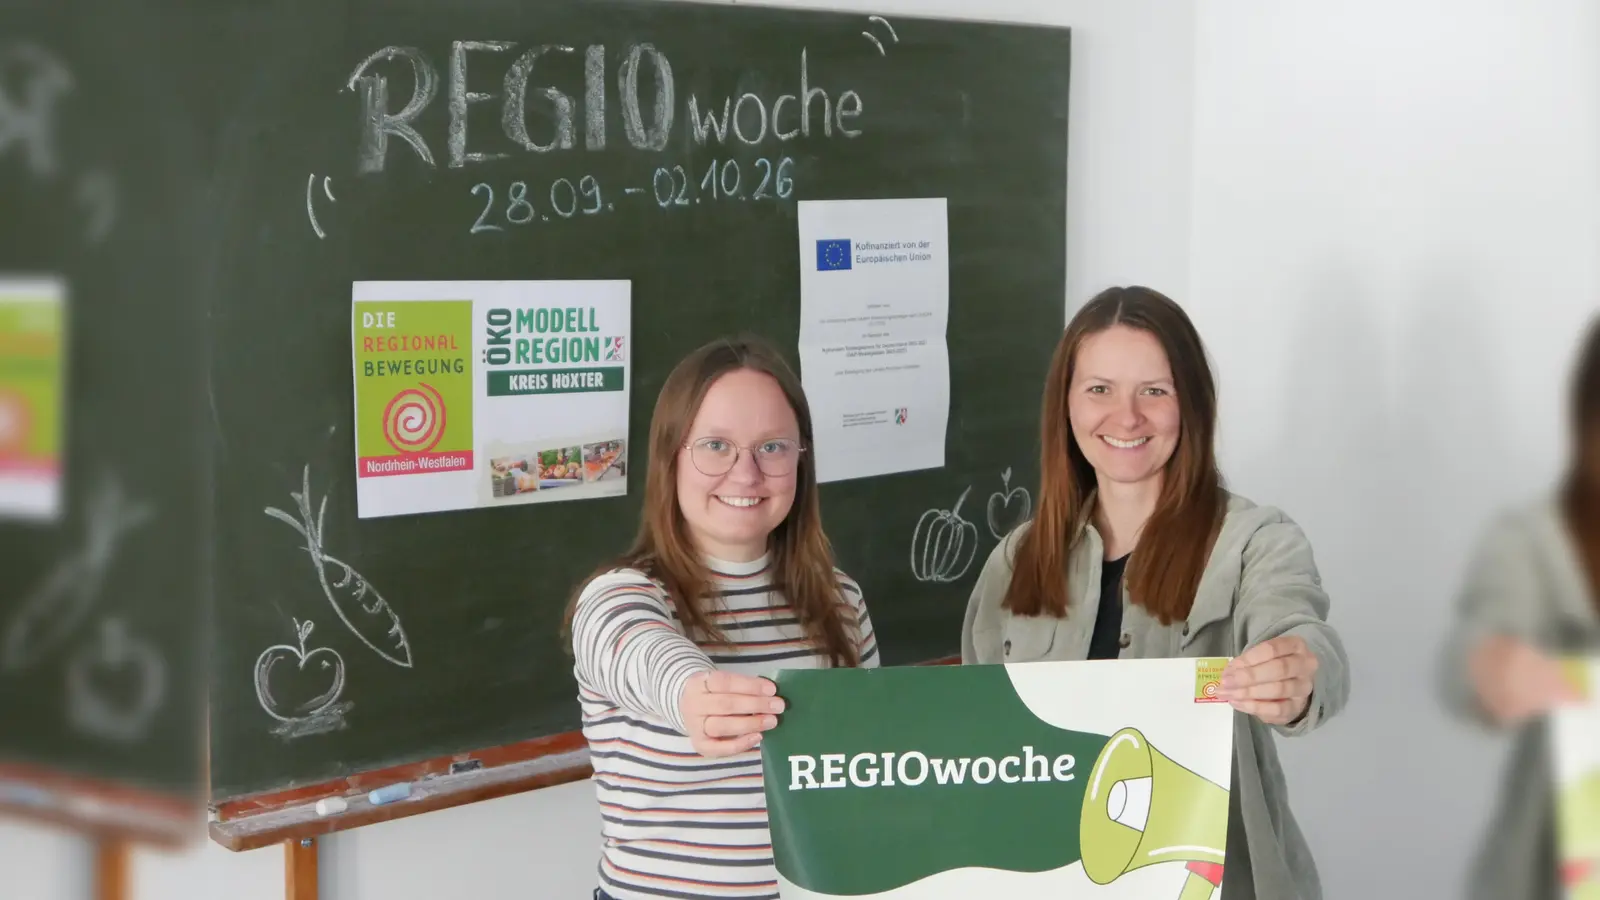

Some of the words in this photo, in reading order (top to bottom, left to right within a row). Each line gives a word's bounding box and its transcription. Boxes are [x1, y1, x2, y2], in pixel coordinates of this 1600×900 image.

[855, 241, 901, 251] Kofinanziert
[918, 240, 931, 249] der
[855, 253, 908, 264] Europäischen
[909, 252, 932, 262] Union
[362, 311, 396, 328] DIE
[515, 307, 600, 333] MODELL
[363, 334, 459, 352] REGIONAL
[482, 308, 512, 365] ÖKO
[515, 336, 600, 364] REGION
[363, 358, 464, 376] BEWEGUNG
[509, 373, 548, 391] KREIS
[552, 371, 604, 389] HÖXTER
[366, 455, 466, 473] Nordrhein-Westfalen
[787, 745, 1076, 791] REGIOwoche
